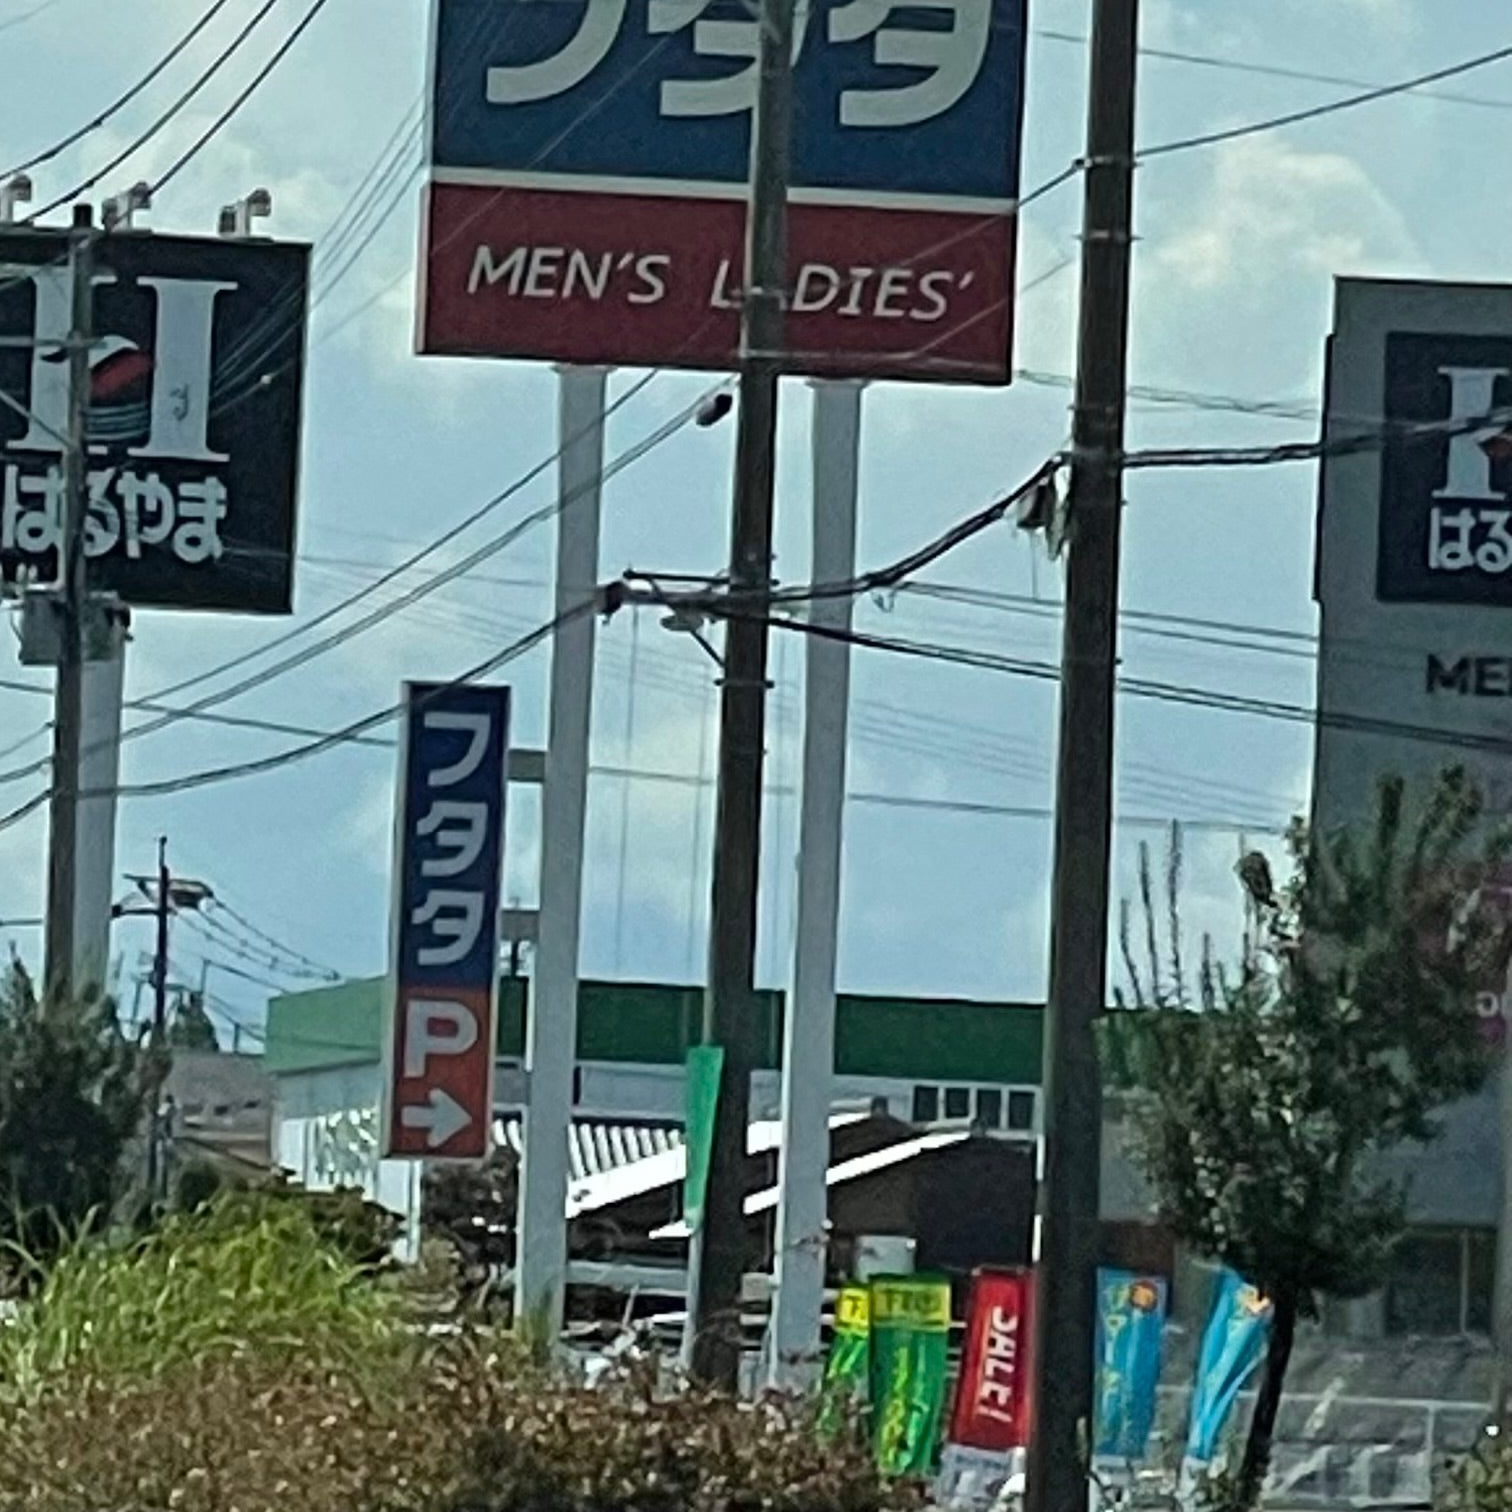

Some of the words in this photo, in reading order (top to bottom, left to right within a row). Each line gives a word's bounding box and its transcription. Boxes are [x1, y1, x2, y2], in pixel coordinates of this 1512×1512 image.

[467, 245, 671, 306] MEN'S
[710, 259, 974, 322] LDIES'
[1, 463, 229, 565] はるやま
[411, 711, 491, 966] フタタ
[403, 999, 479, 1079] P
